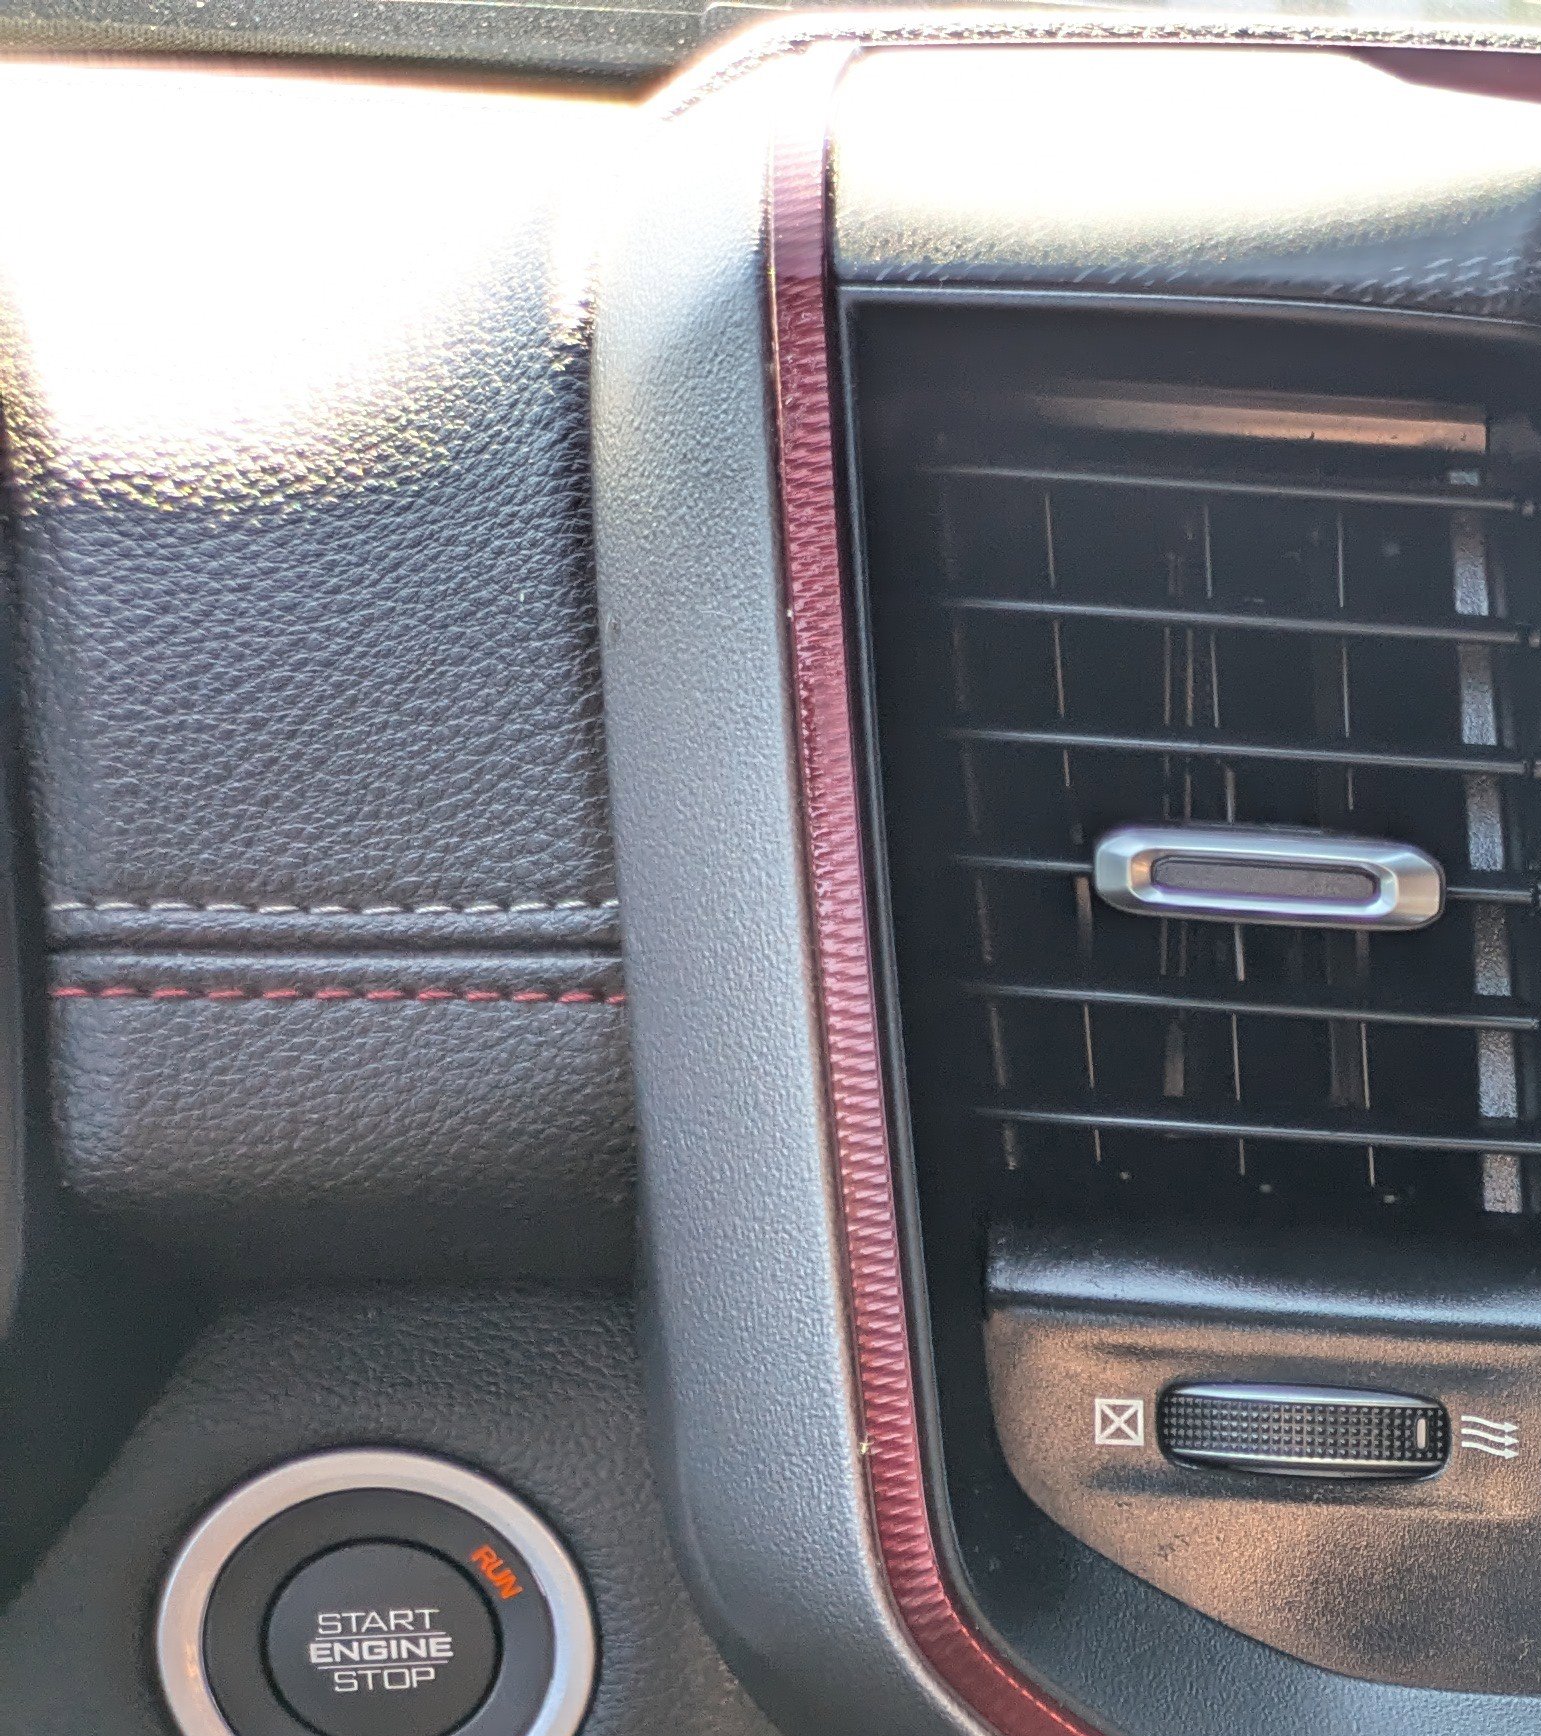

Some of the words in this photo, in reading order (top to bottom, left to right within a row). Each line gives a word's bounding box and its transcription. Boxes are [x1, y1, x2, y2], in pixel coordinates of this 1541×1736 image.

[470, 1544, 523, 1600] RUN
[317, 1608, 440, 1636] START
[309, 1636, 453, 1665] ENGINE
[333, 1666, 436, 1693] STOP
